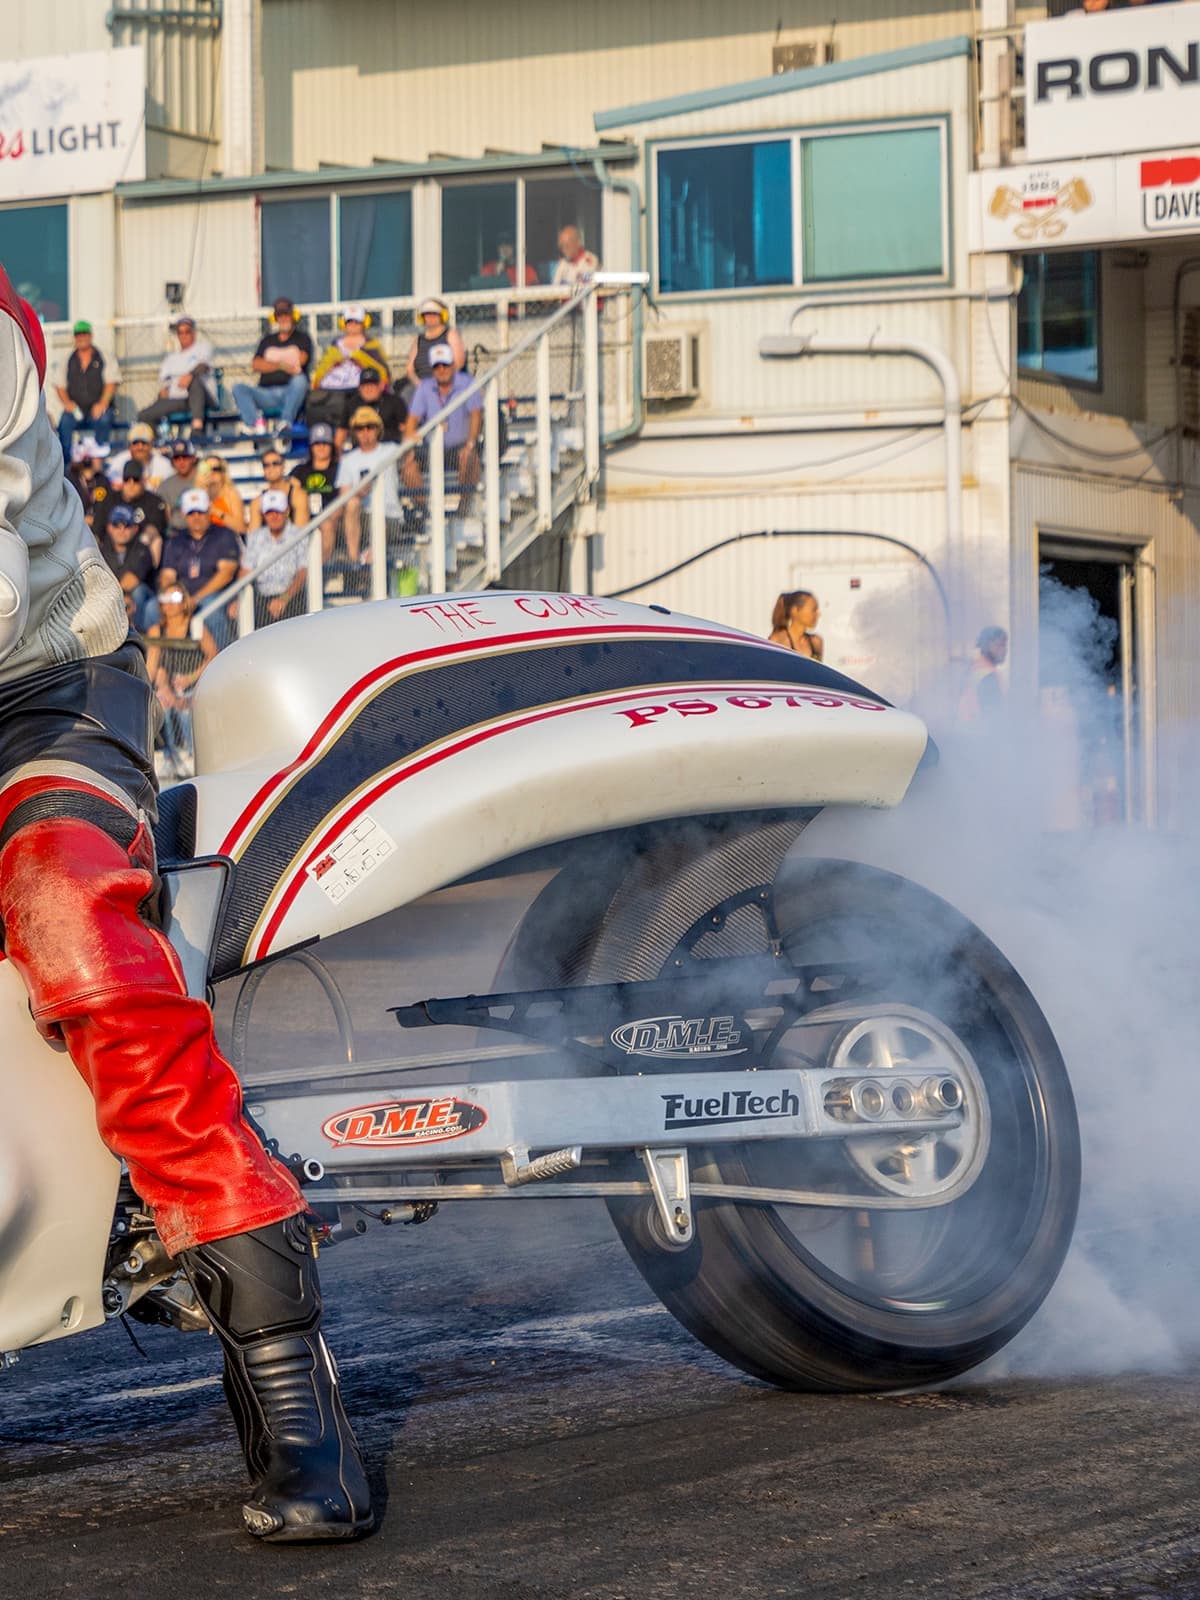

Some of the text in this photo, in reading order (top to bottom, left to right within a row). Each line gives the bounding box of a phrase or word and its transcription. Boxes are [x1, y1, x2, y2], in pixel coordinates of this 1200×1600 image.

[1036, 42, 1200, 102] RON
[31, 120, 122, 157] LIGHT
[409, 595, 618, 636] THE CURE
[612, 698, 719, 729] PS
[629, 1015, 741, 1053] D.M.E.
[344, 1100, 462, 1142] D.M.E.
[660, 1088, 800, 1119] FuelTech
